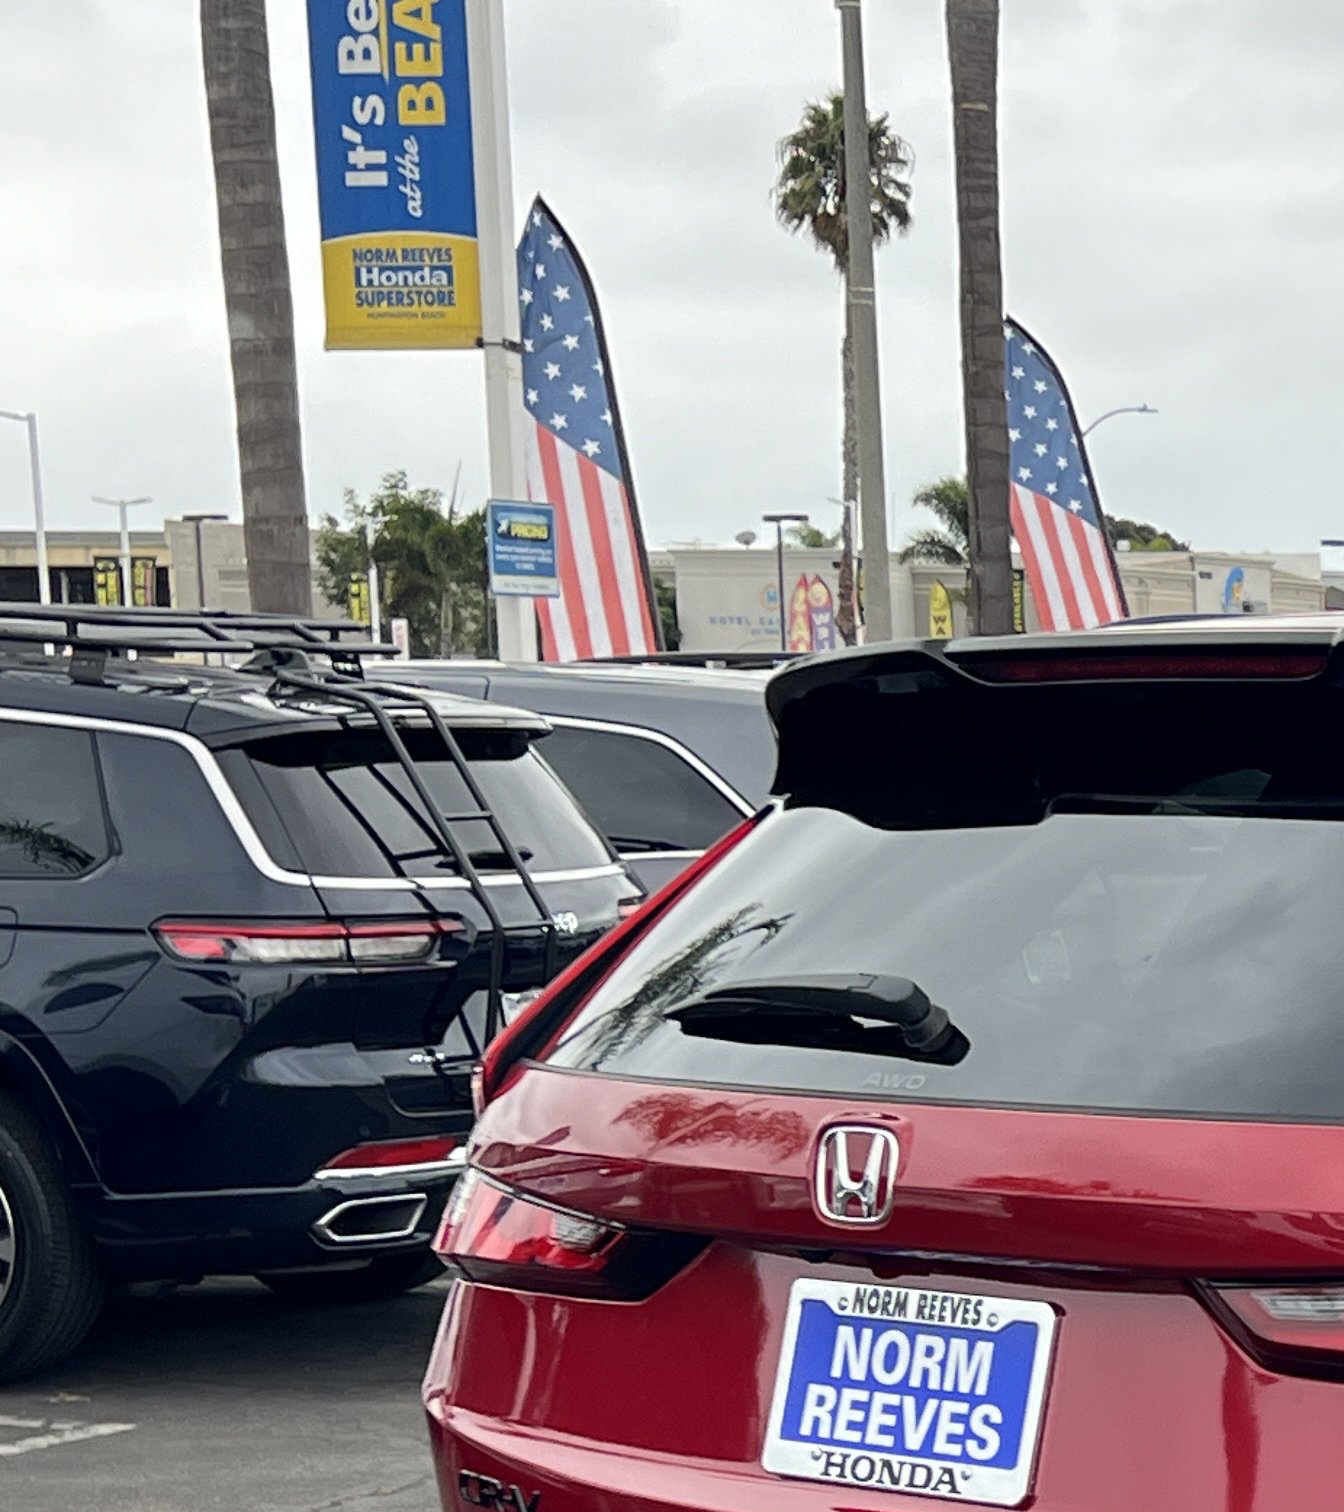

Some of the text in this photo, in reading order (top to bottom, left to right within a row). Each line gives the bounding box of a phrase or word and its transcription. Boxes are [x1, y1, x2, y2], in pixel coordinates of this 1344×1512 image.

[337, 0, 388, 187] It's Be
[391, 0, 447, 218] at the BEA
[352, 247, 453, 263] NORM REEVES
[359, 266, 449, 287] Honda
[355, 290, 456, 308] SUPERSTORE
[861, 1072, 926, 1091] AWD
[851, 1286, 984, 1327] NORM REEVES
[829, 1324, 996, 1397] NORM
[797, 1382, 1004, 1462] REEVES
[818, 1450, 962, 1495] HONDA
